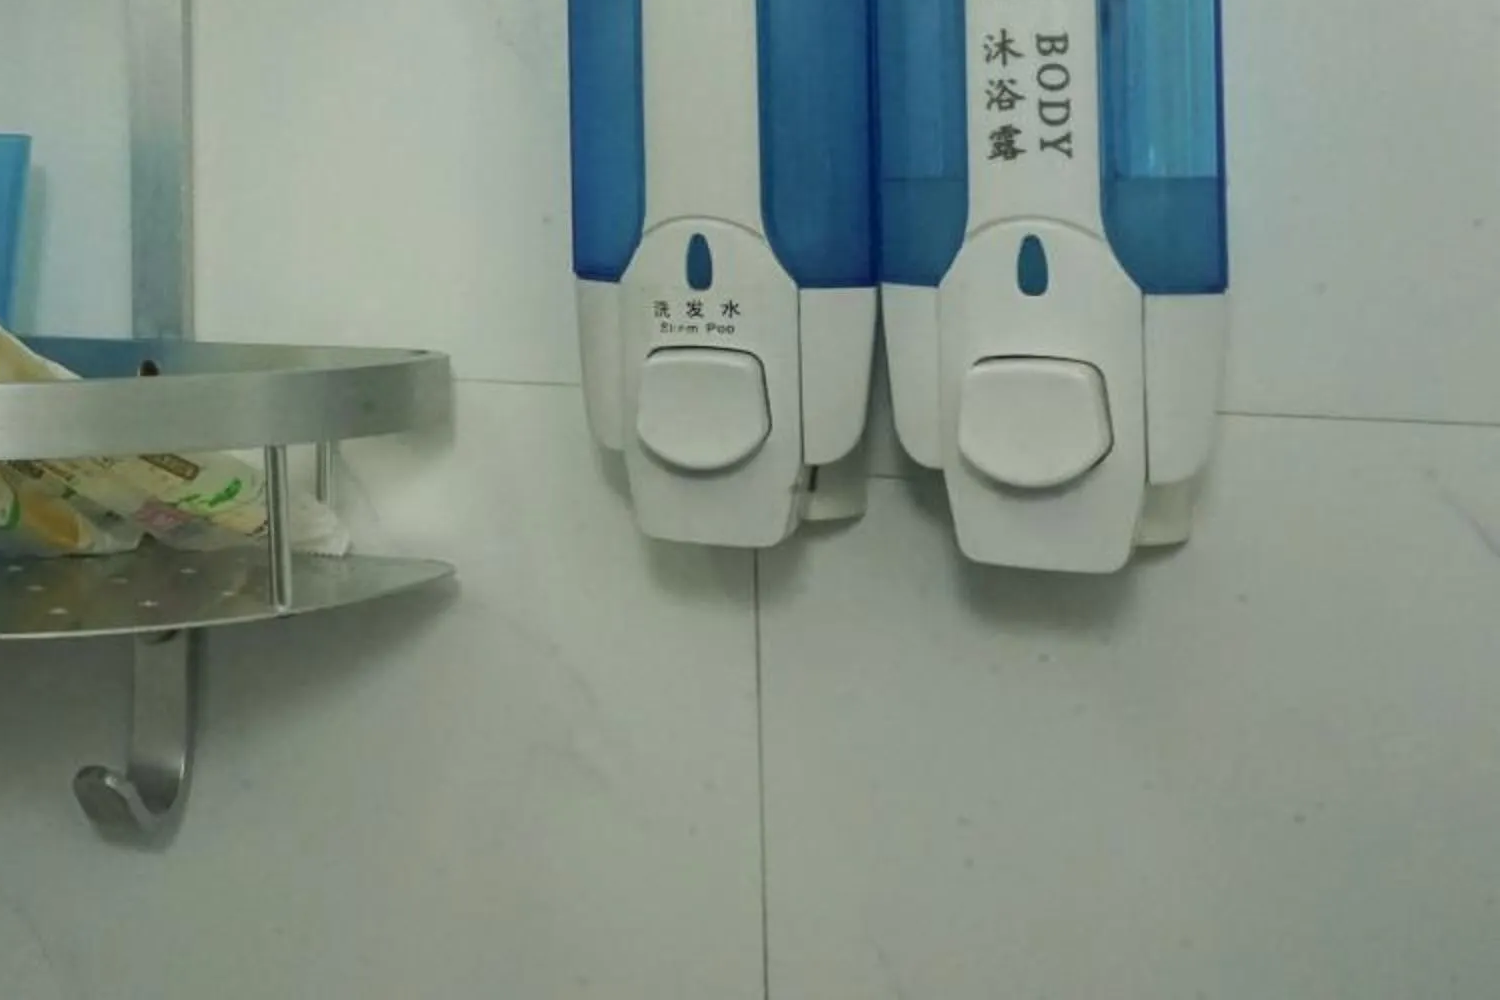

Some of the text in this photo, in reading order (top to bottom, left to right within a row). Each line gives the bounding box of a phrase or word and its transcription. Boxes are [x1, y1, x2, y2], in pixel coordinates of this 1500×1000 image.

[982, 28, 1027, 162] 沐浴露
[1035, 32, 1074, 160] BODY
[652, 299, 742, 319] 洗发水
